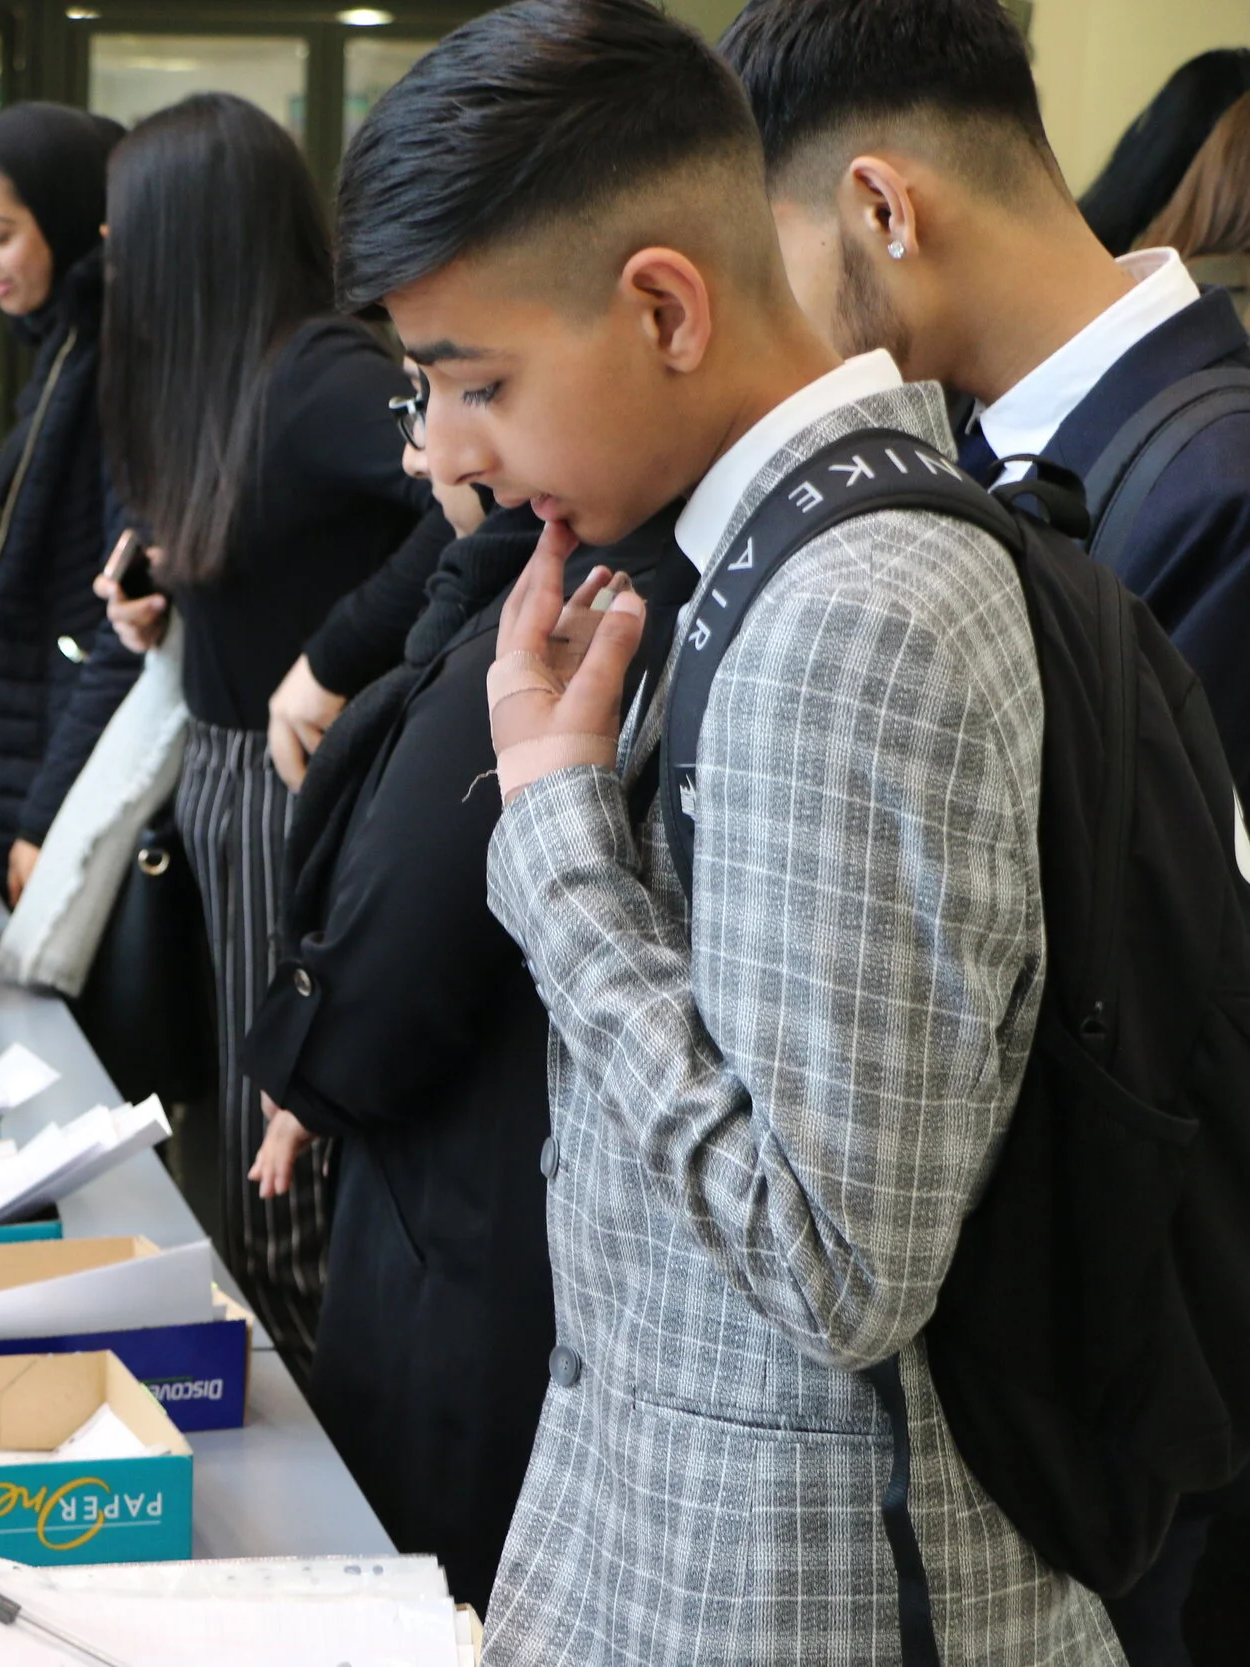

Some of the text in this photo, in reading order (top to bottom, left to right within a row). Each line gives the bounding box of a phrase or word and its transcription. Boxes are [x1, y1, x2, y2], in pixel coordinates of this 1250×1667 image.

[687, 448, 963, 651] NIKE AIR
[59, 1491, 163, 1521] PAPER
